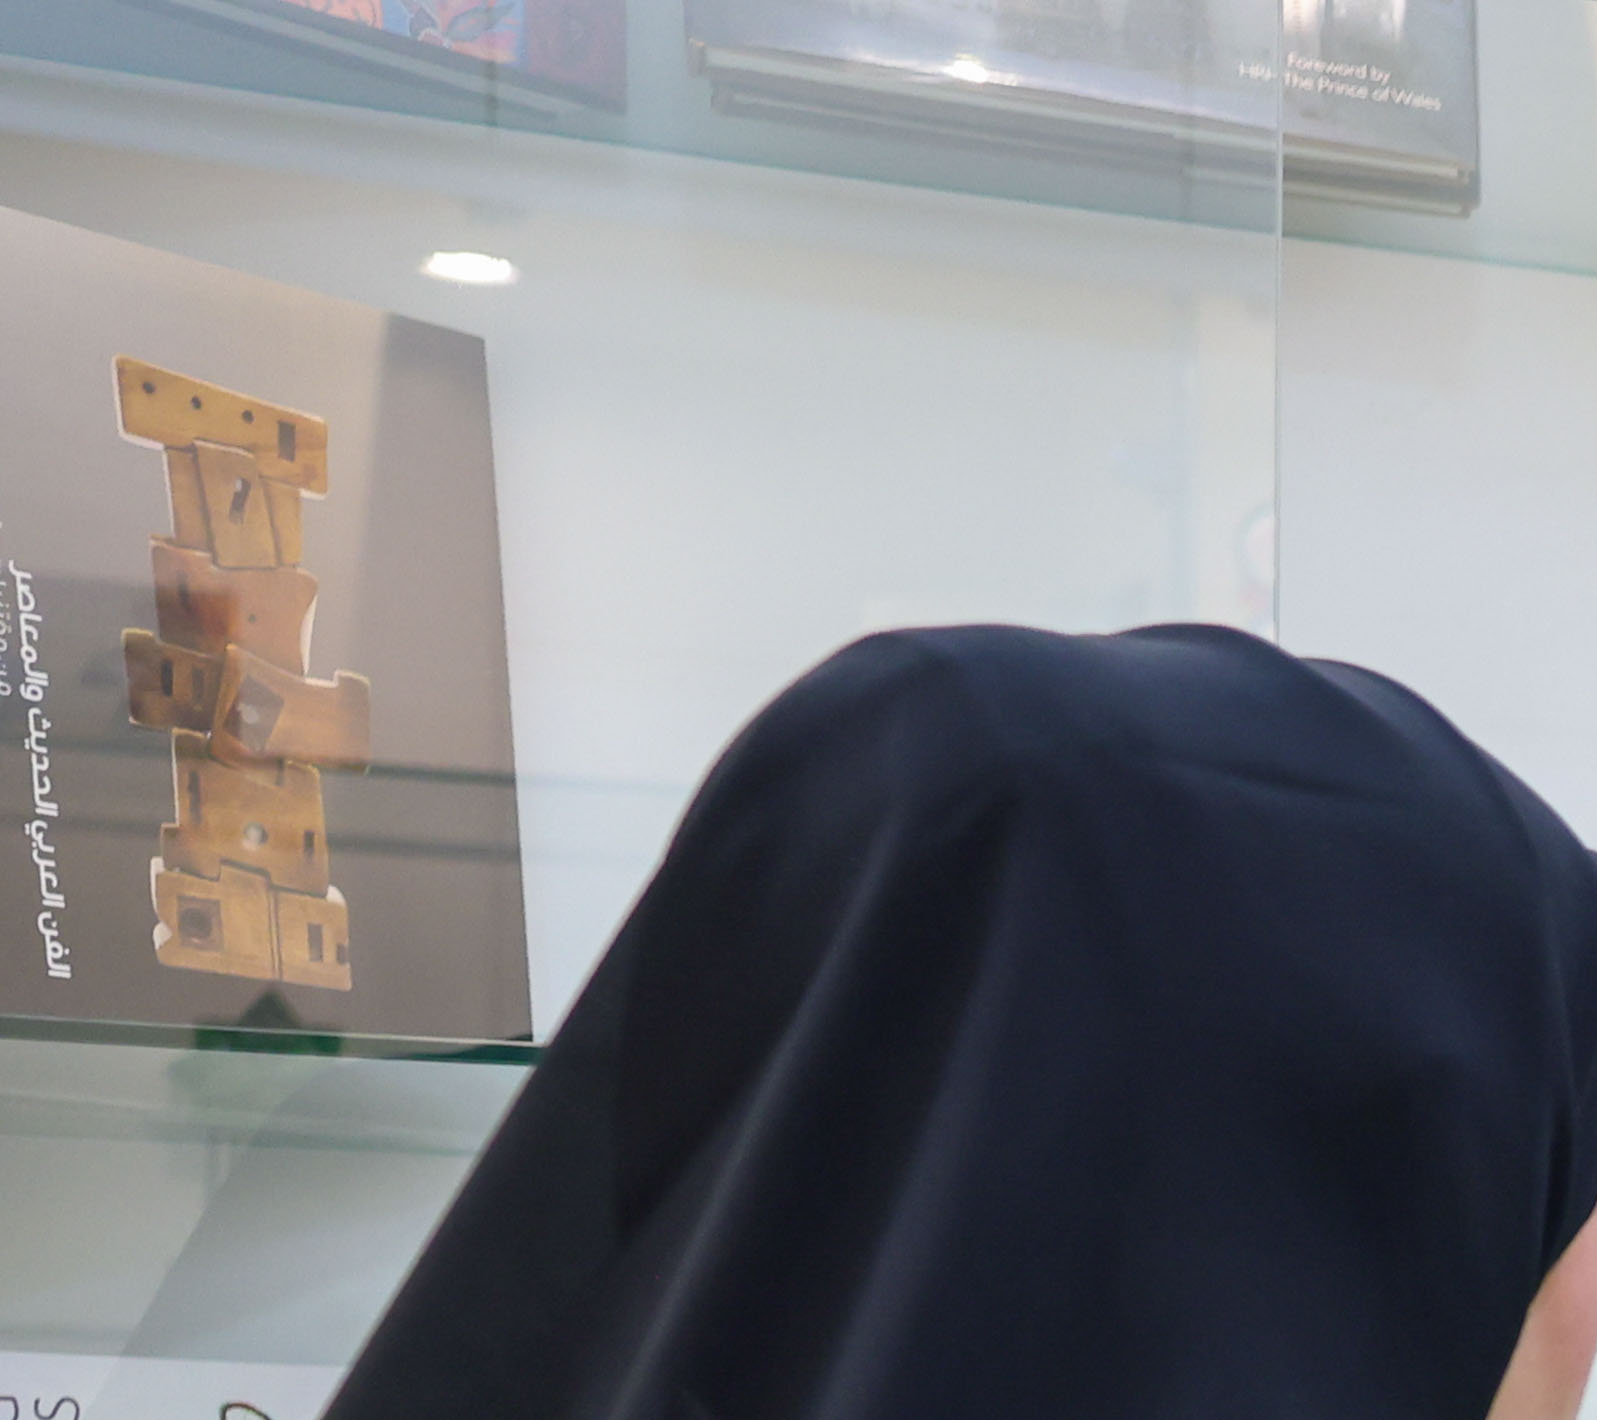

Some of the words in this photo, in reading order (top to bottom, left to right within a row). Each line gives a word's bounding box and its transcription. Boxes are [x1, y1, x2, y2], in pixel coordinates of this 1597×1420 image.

[8, 558, 49, 703] والمعاصر
[26, 706, 59, 817] الحديث
[23, 819, 66, 909] العربي
[36, 911, 71, 980] الفن
